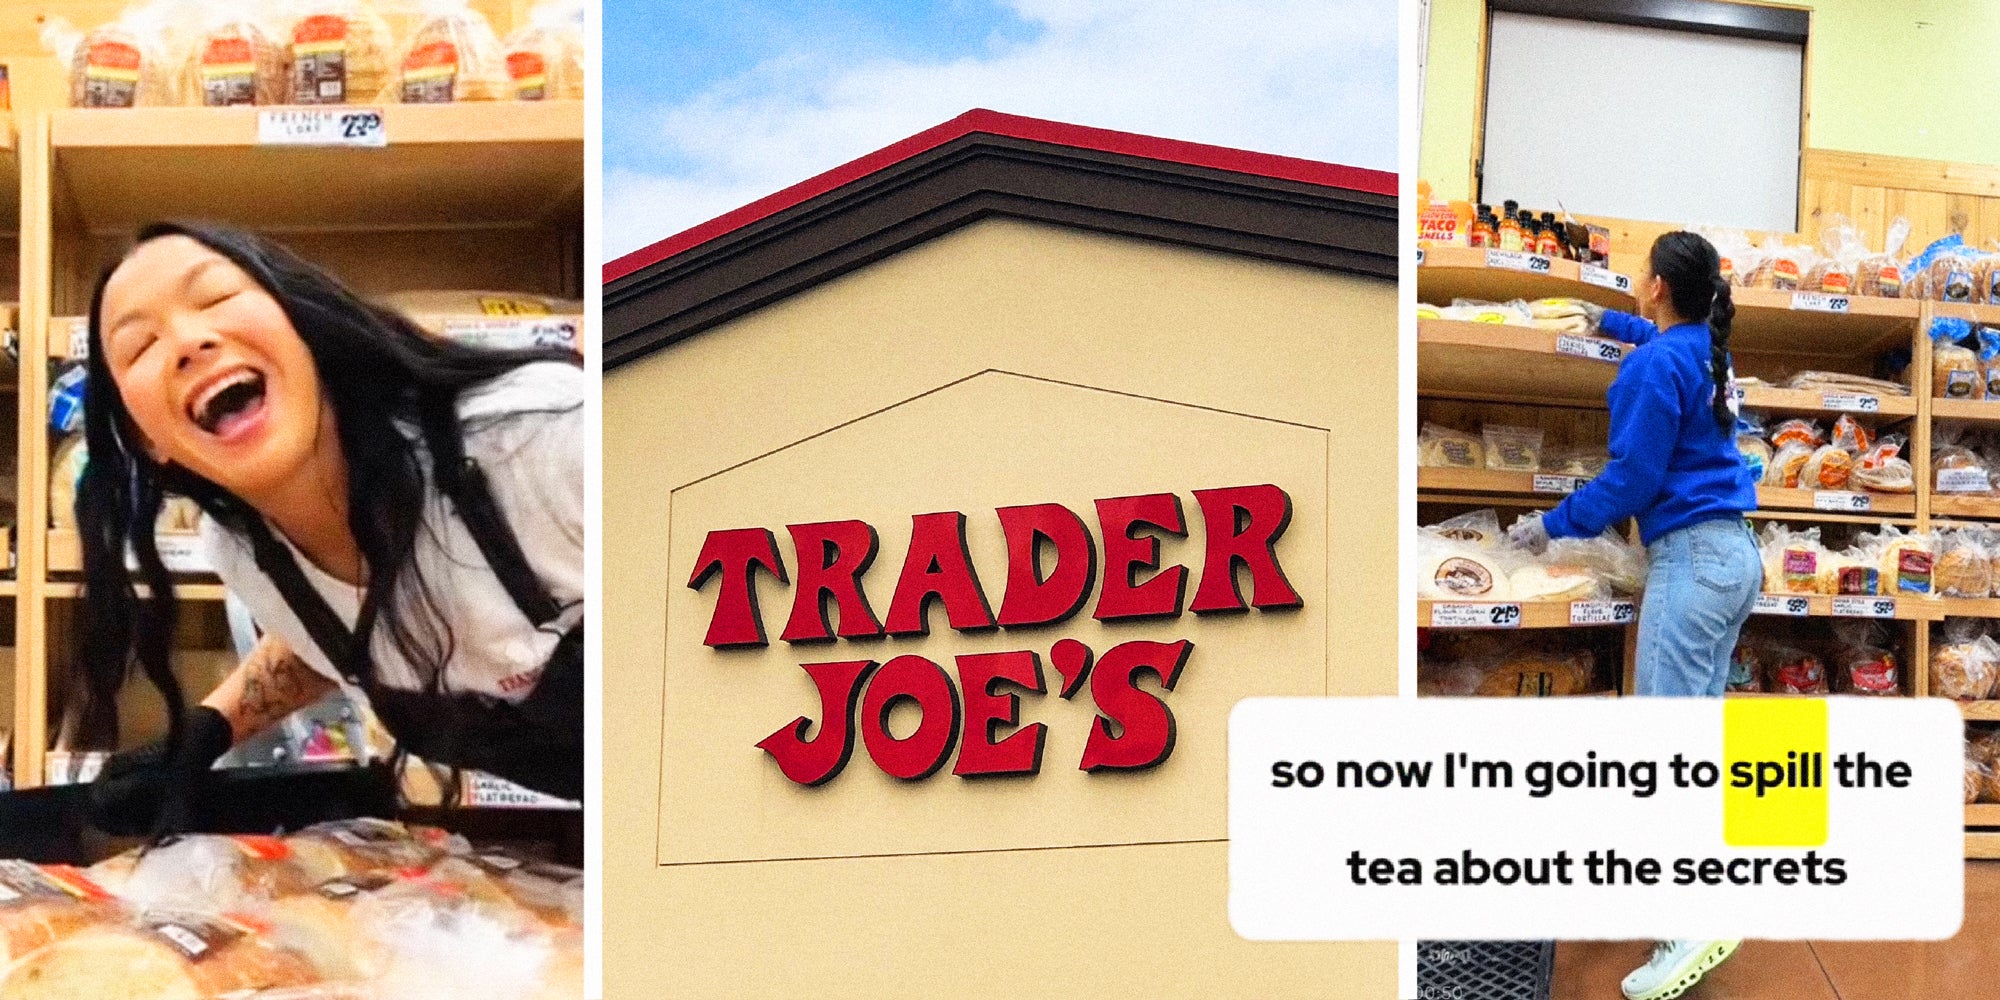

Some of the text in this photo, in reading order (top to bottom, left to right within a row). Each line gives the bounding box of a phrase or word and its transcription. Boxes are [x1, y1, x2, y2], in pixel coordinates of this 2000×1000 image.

[1418, 232, 1454, 240] SHELLS
[1421, 219, 1457, 231] TACO
[687, 484, 1304, 648] TRADER
[754, 639, 1195, 787] JOE'S
